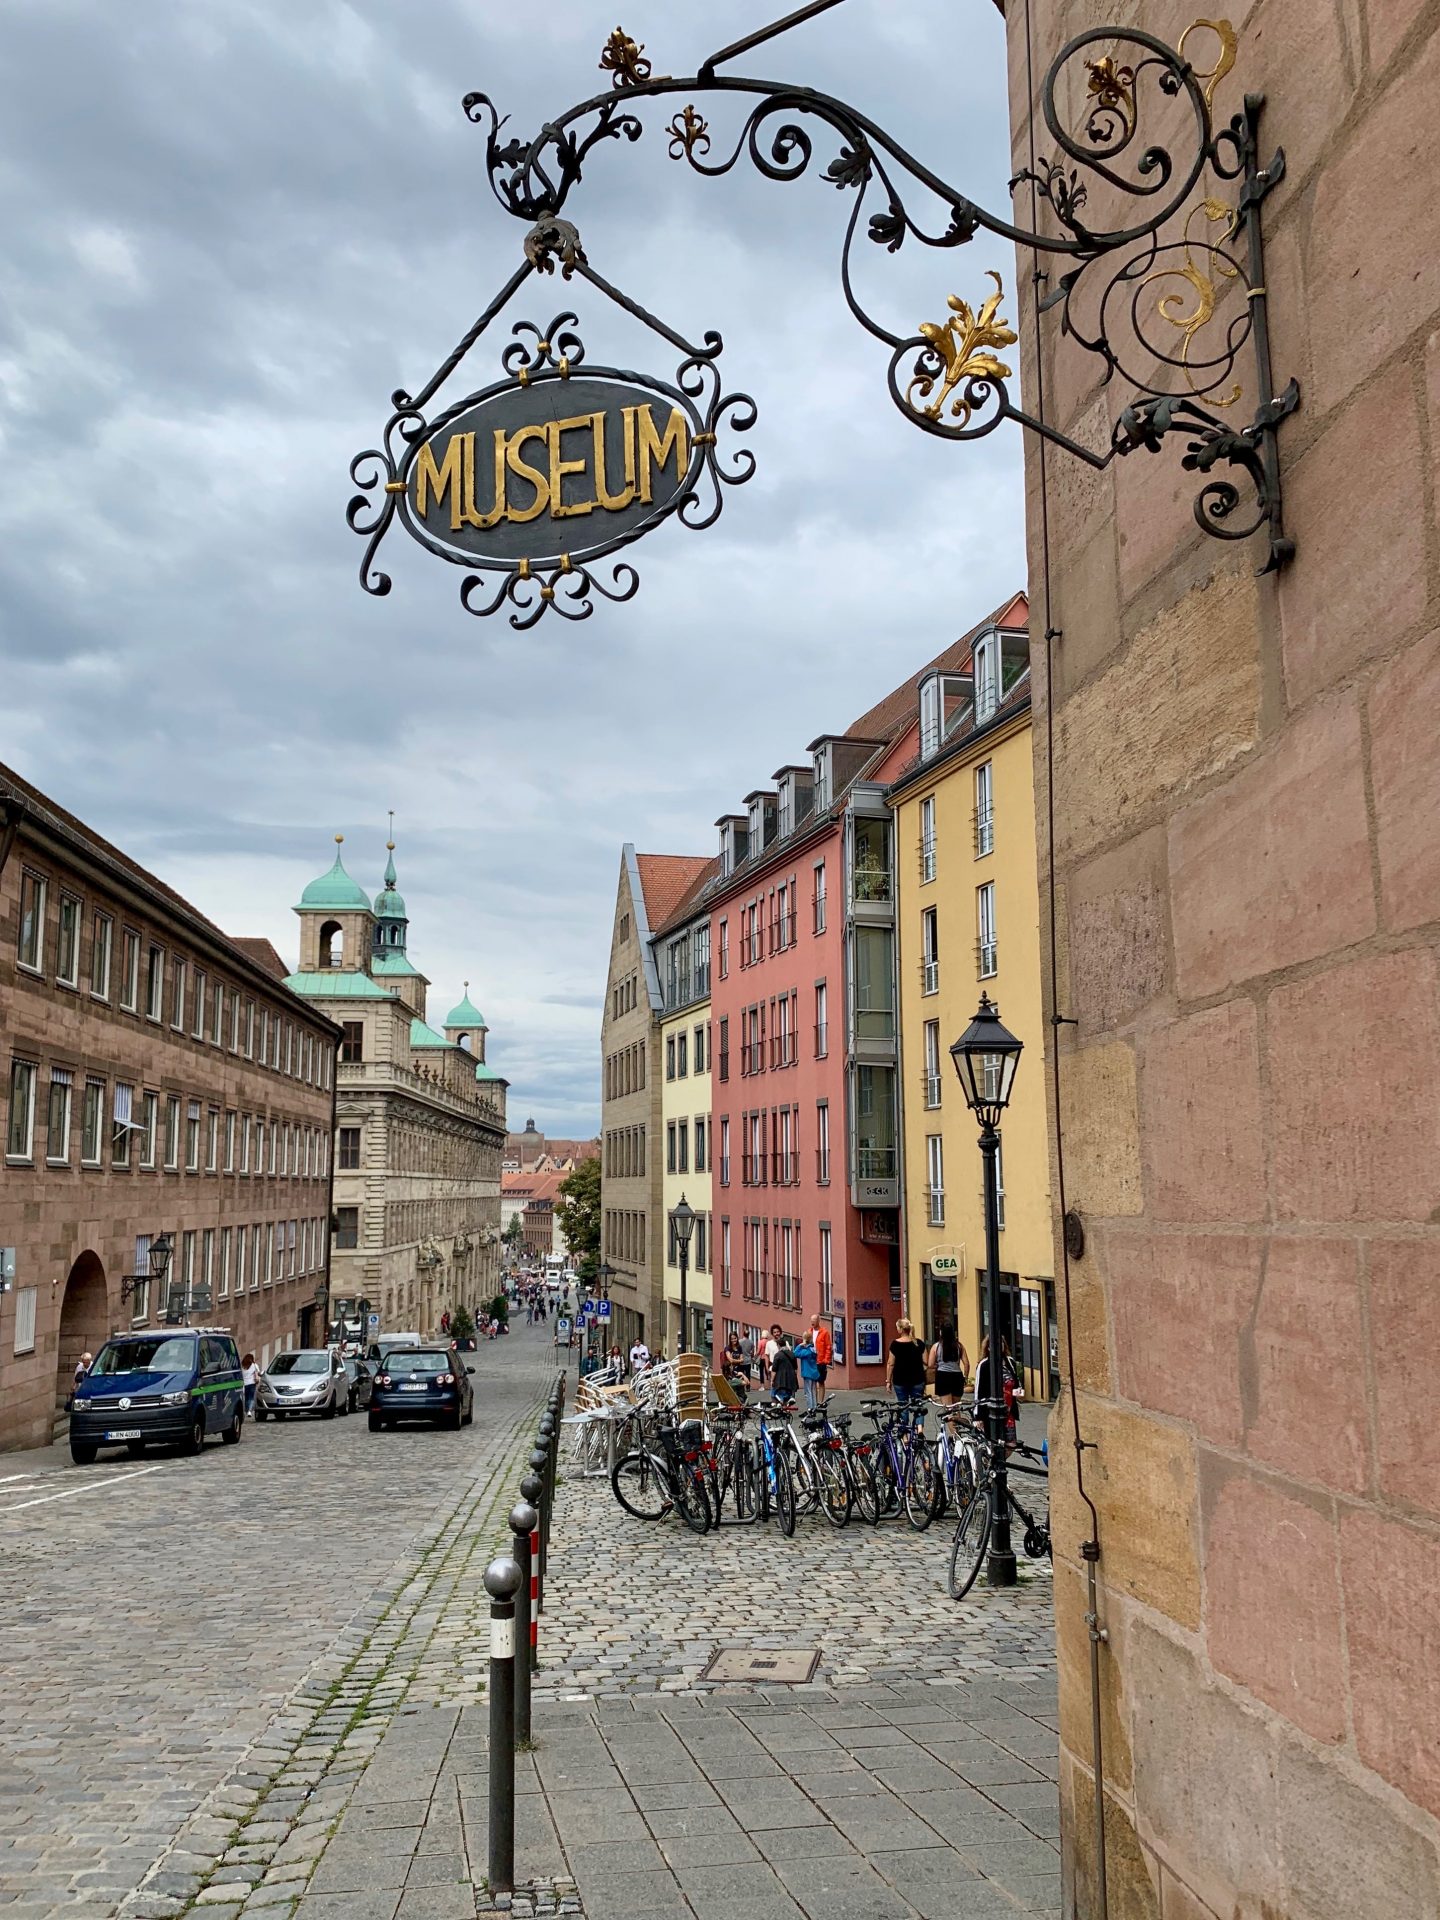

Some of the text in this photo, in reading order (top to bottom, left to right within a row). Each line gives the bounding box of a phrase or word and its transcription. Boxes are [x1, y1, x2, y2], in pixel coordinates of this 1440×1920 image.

[415, 403, 690, 530] MUSEUM
[935, 1258, 958, 1269] GEA
[600, 1302, 608, 1314] P
